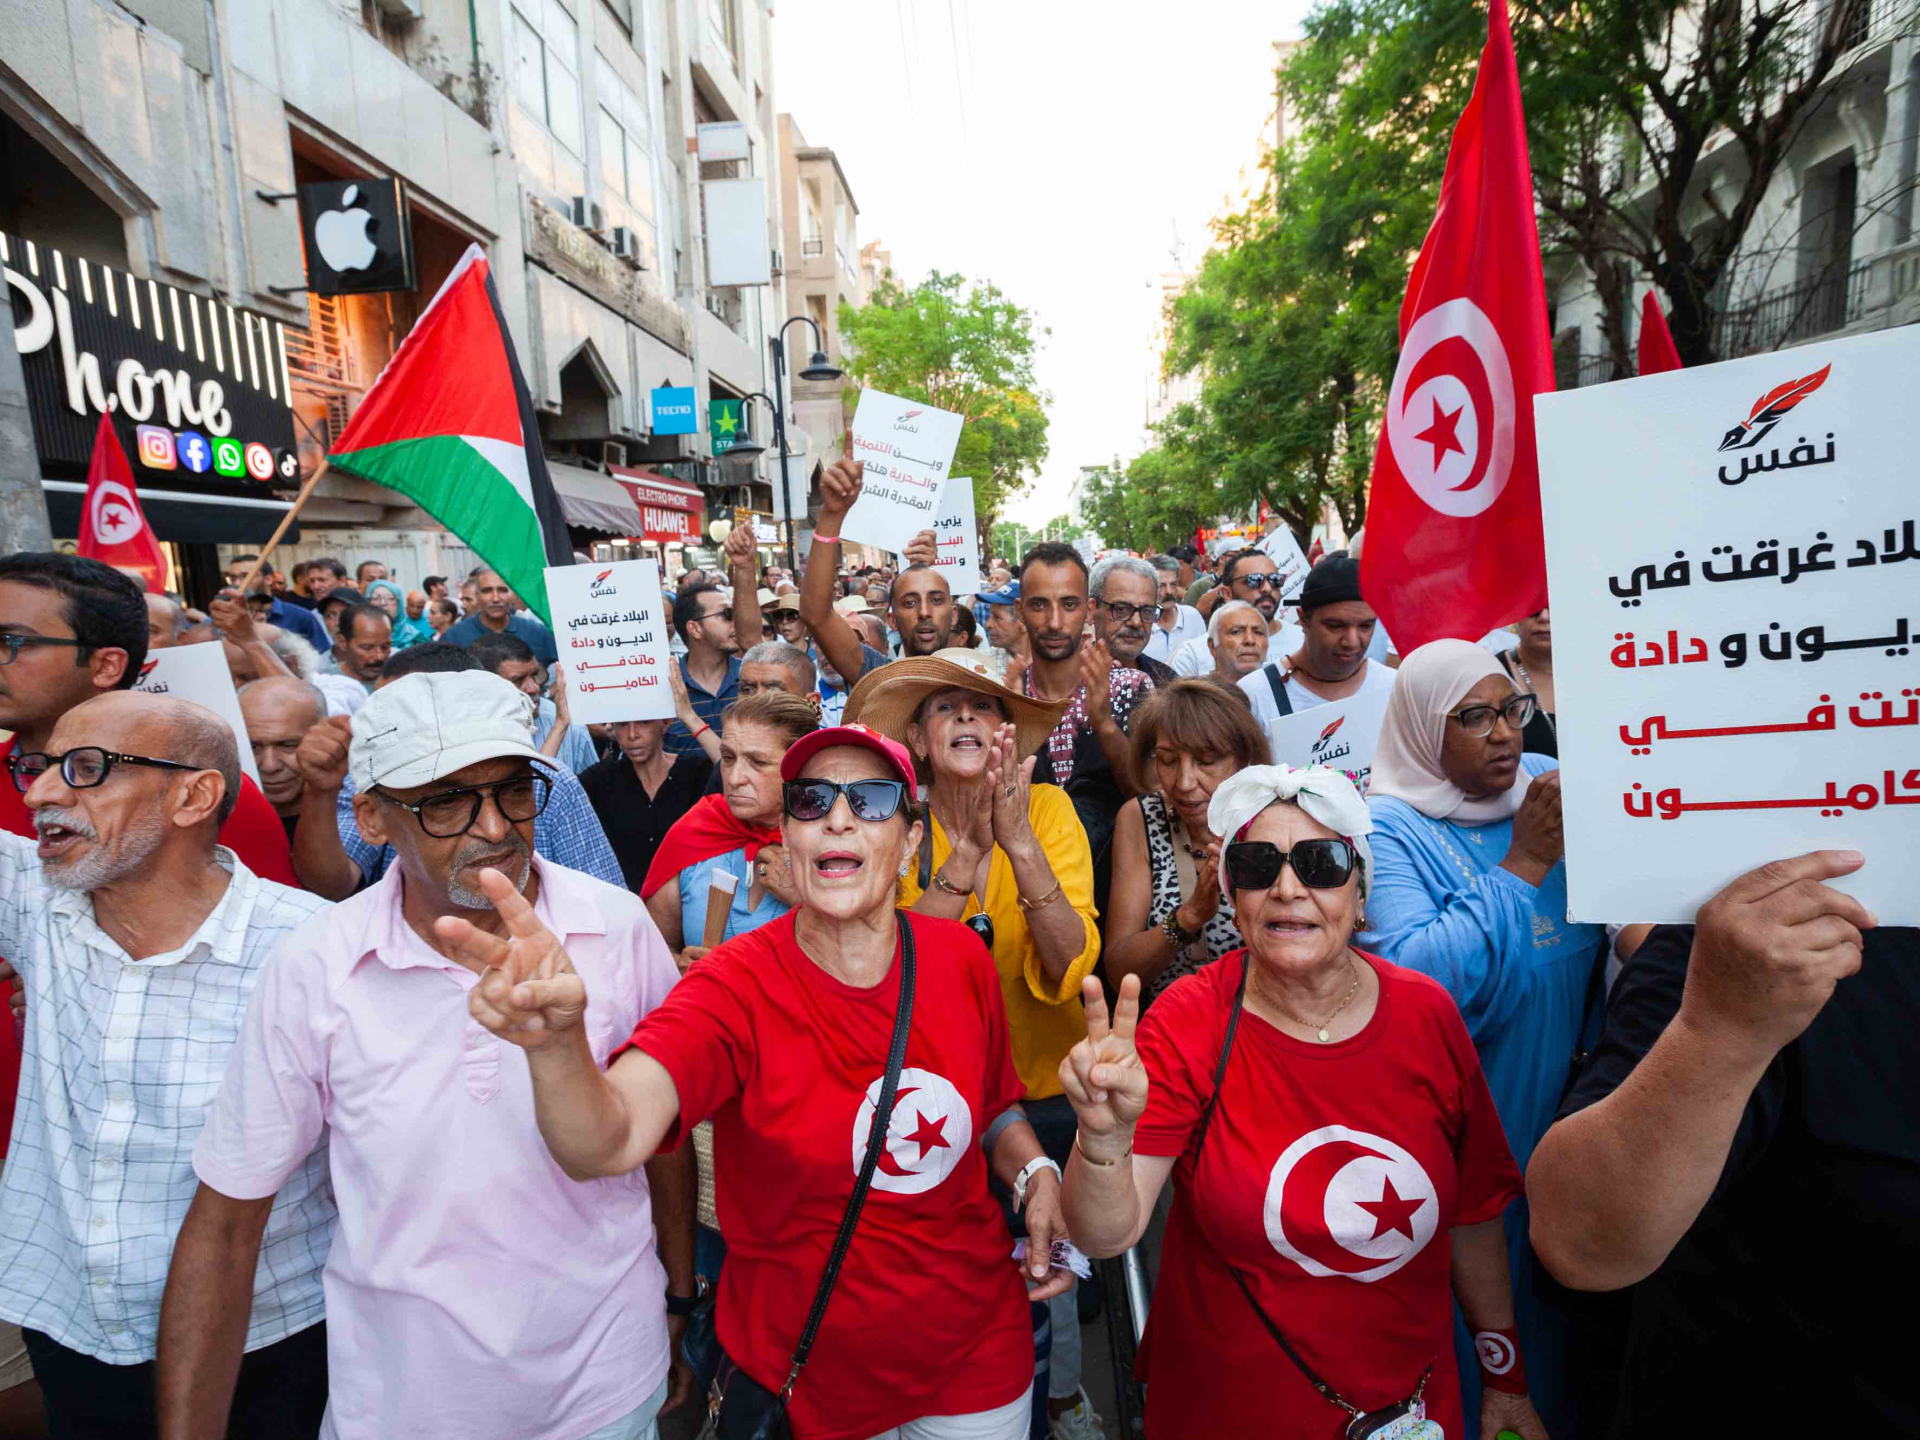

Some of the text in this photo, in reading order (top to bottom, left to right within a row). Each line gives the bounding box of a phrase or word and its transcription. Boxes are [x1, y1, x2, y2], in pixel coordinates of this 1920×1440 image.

[656, 405, 691, 415] TECNO
[894, 422, 919, 434] نفس
[716, 440, 735, 448] STA
[853, 434, 892, 454] التنمية
[1717, 432, 1836, 486] نفس
[889, 467, 937, 492] والحرية
[637, 487, 688, 507] ELECTRO PHONE
[862, 484, 932, 511] المقدرة الشر
[644, 507, 689, 534] HUAWEI
[940, 516, 962, 529] يزي
[959, 557, 966, 566] و
[1608, 520, 1920, 608] لاد غرقت في
[590, 586, 617, 598] نفس
[568, 610, 649, 631] البلاد غرقت في
[571, 632, 653, 648] الديون و دادة
[1610, 618, 1920, 669] يون و دادة
[576, 654, 655, 673] ماتت في
[580, 675, 658, 692] الكاميون
[1619, 694, 1836, 755] في
